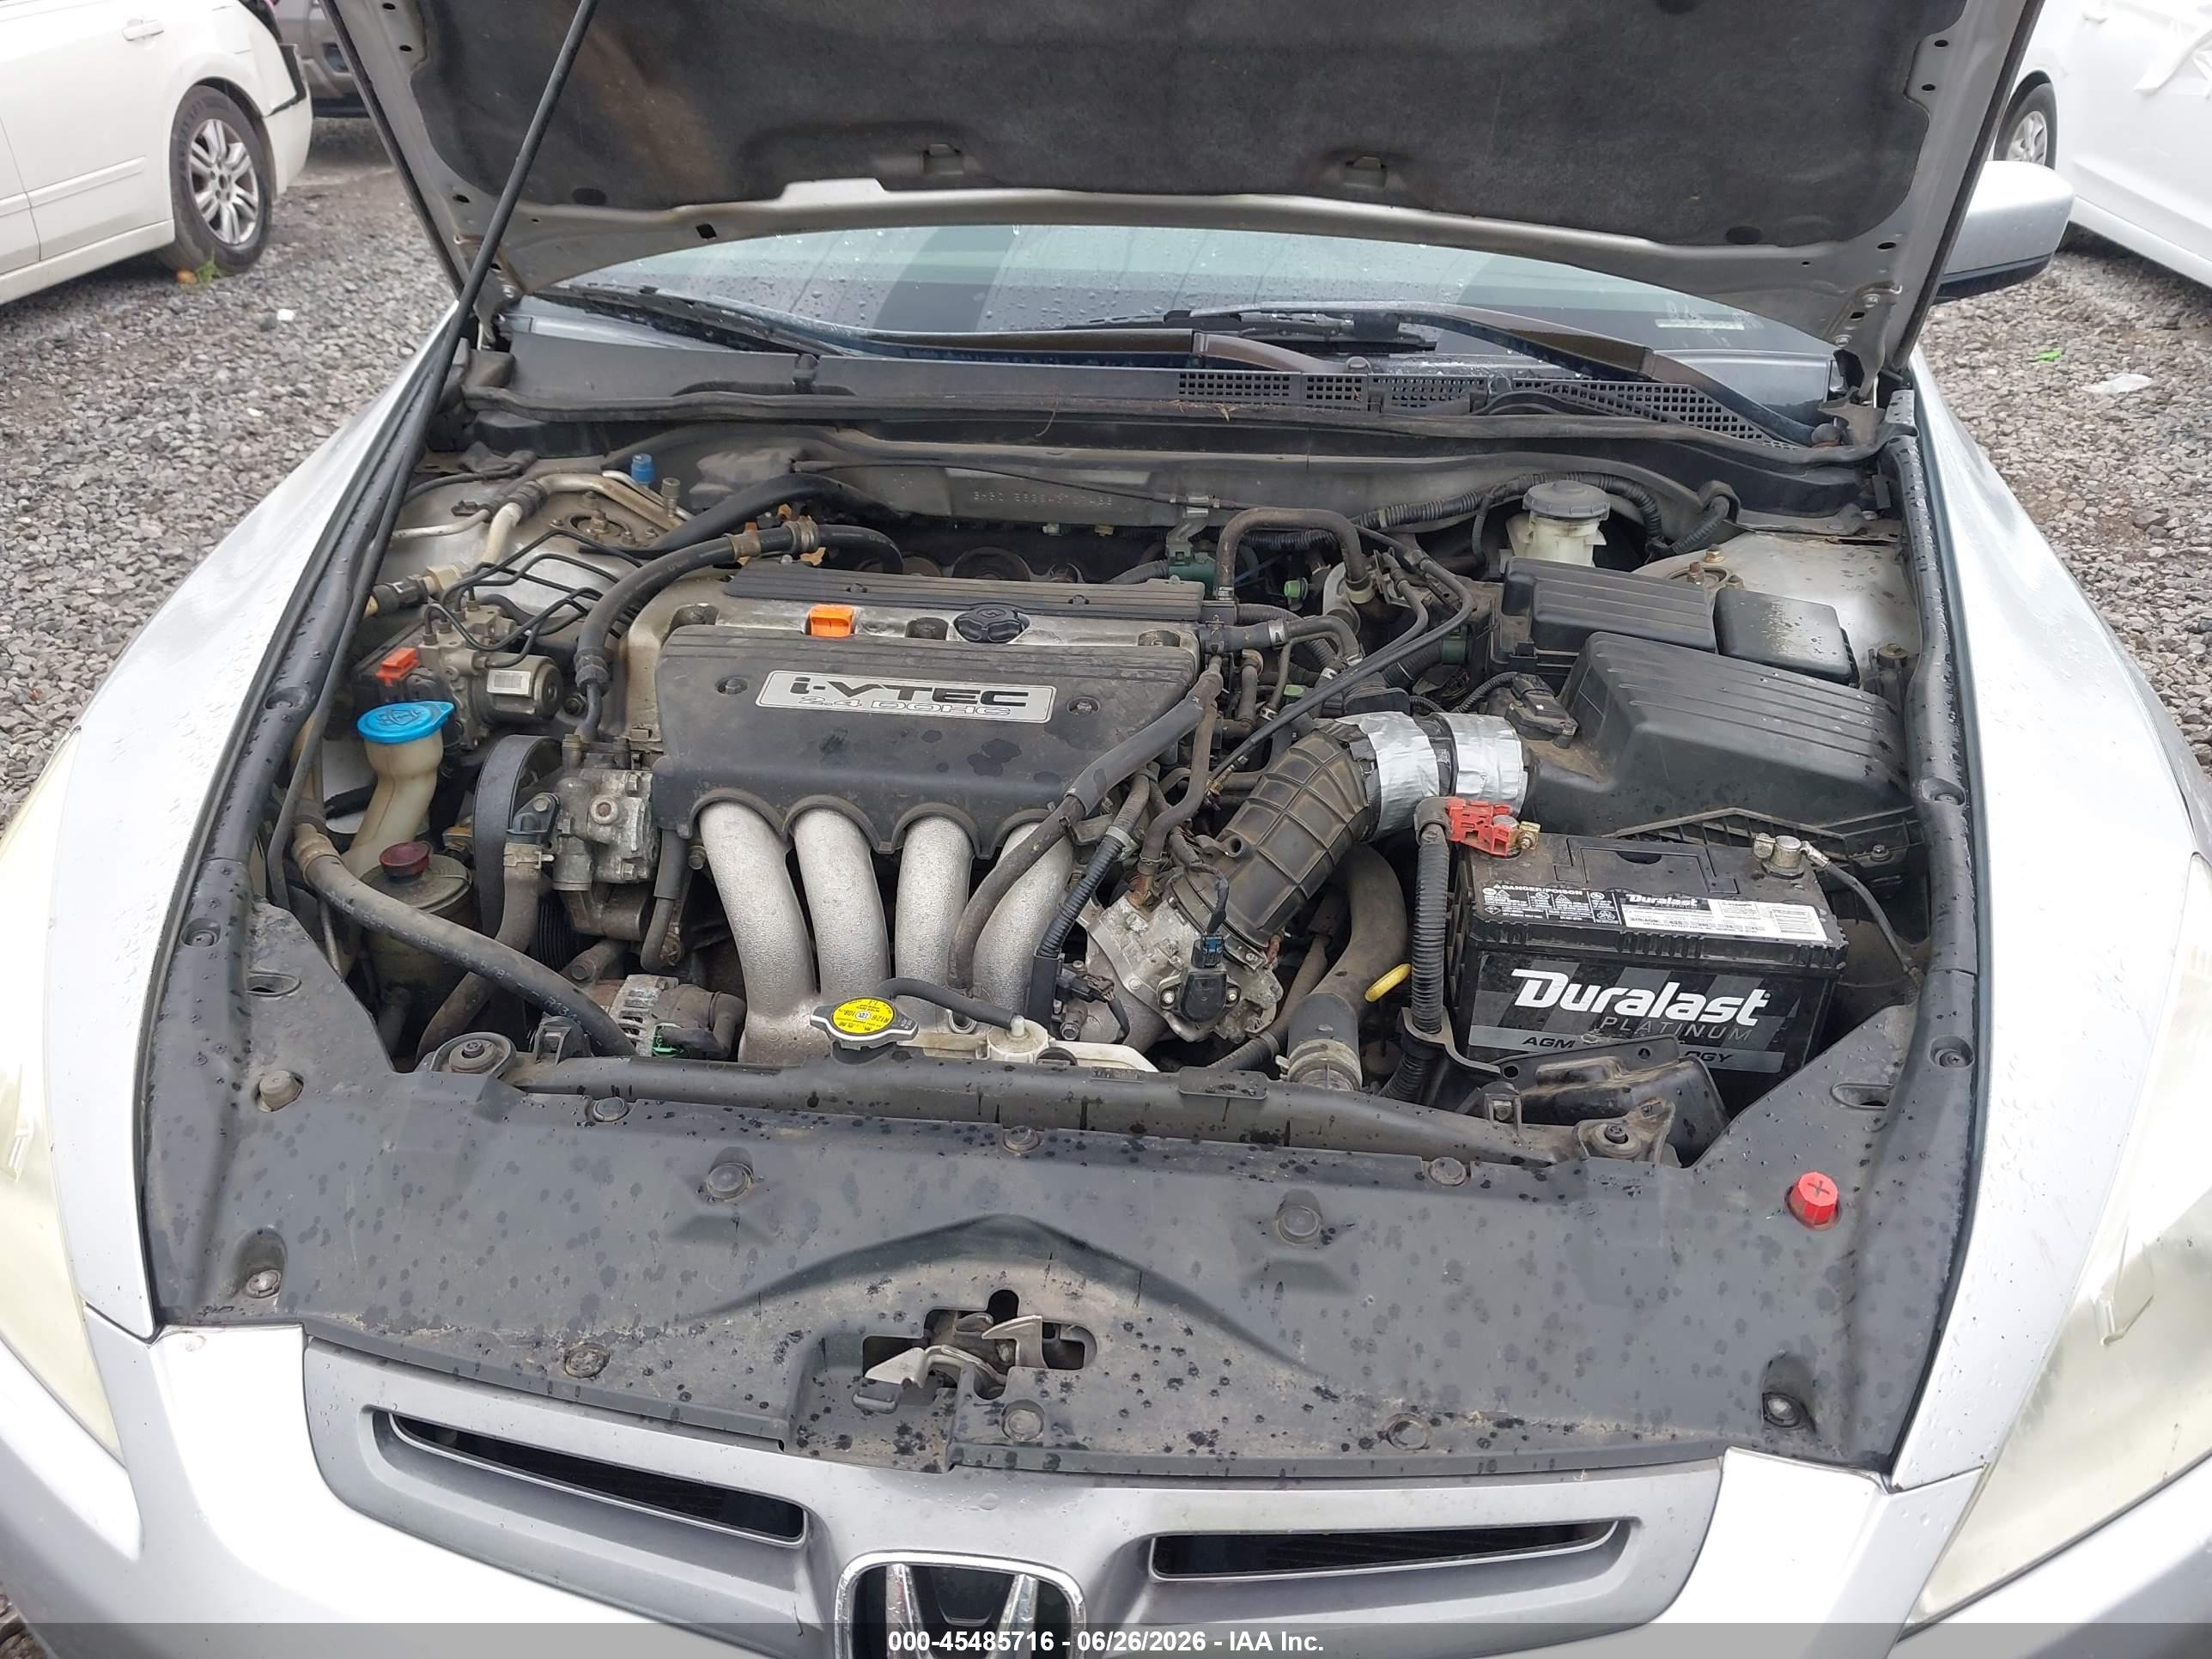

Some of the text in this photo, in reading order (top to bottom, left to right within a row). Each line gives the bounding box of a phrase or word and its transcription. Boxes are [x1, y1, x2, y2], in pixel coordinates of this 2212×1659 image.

[790, 677, 1029, 707] i-VTEC
[797, 696, 1011, 715] 2.4 DOHC
[1626, 893, 1698, 907] Duralast
[1511, 968, 1768, 1026] Duralast
[1600, 1016, 1754, 1042] PLATINUM
[1521, 1036, 1576, 1048] AGM
